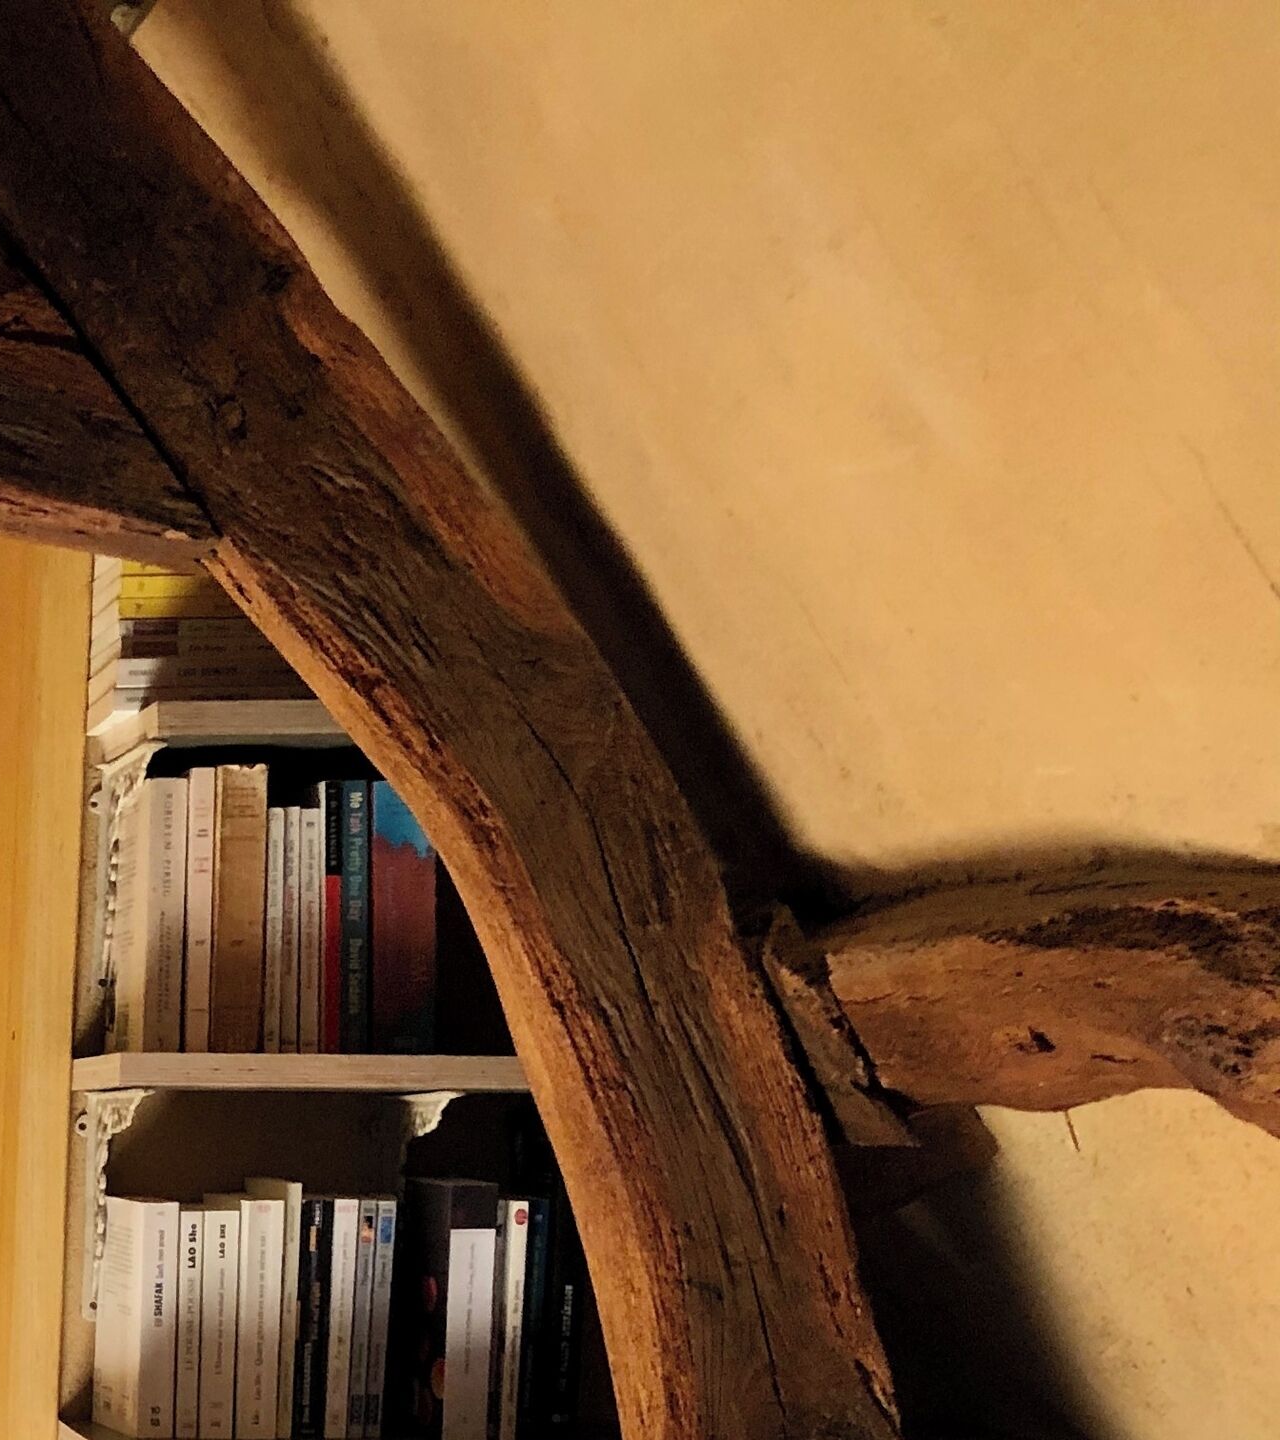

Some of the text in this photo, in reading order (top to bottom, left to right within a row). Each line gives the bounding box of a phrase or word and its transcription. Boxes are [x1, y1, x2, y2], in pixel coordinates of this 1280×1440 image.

[349, 791, 363, 809] Me
[349, 812, 363, 835] Talk
[347, 837, 363, 872] Pretty
[349, 874, 362, 896] One
[347, 899, 362, 922] Day
[187, 1247, 197, 1270] LAO
[218, 1242, 227, 1259] LAO
[154, 1282, 164, 1317] SHAFAK
